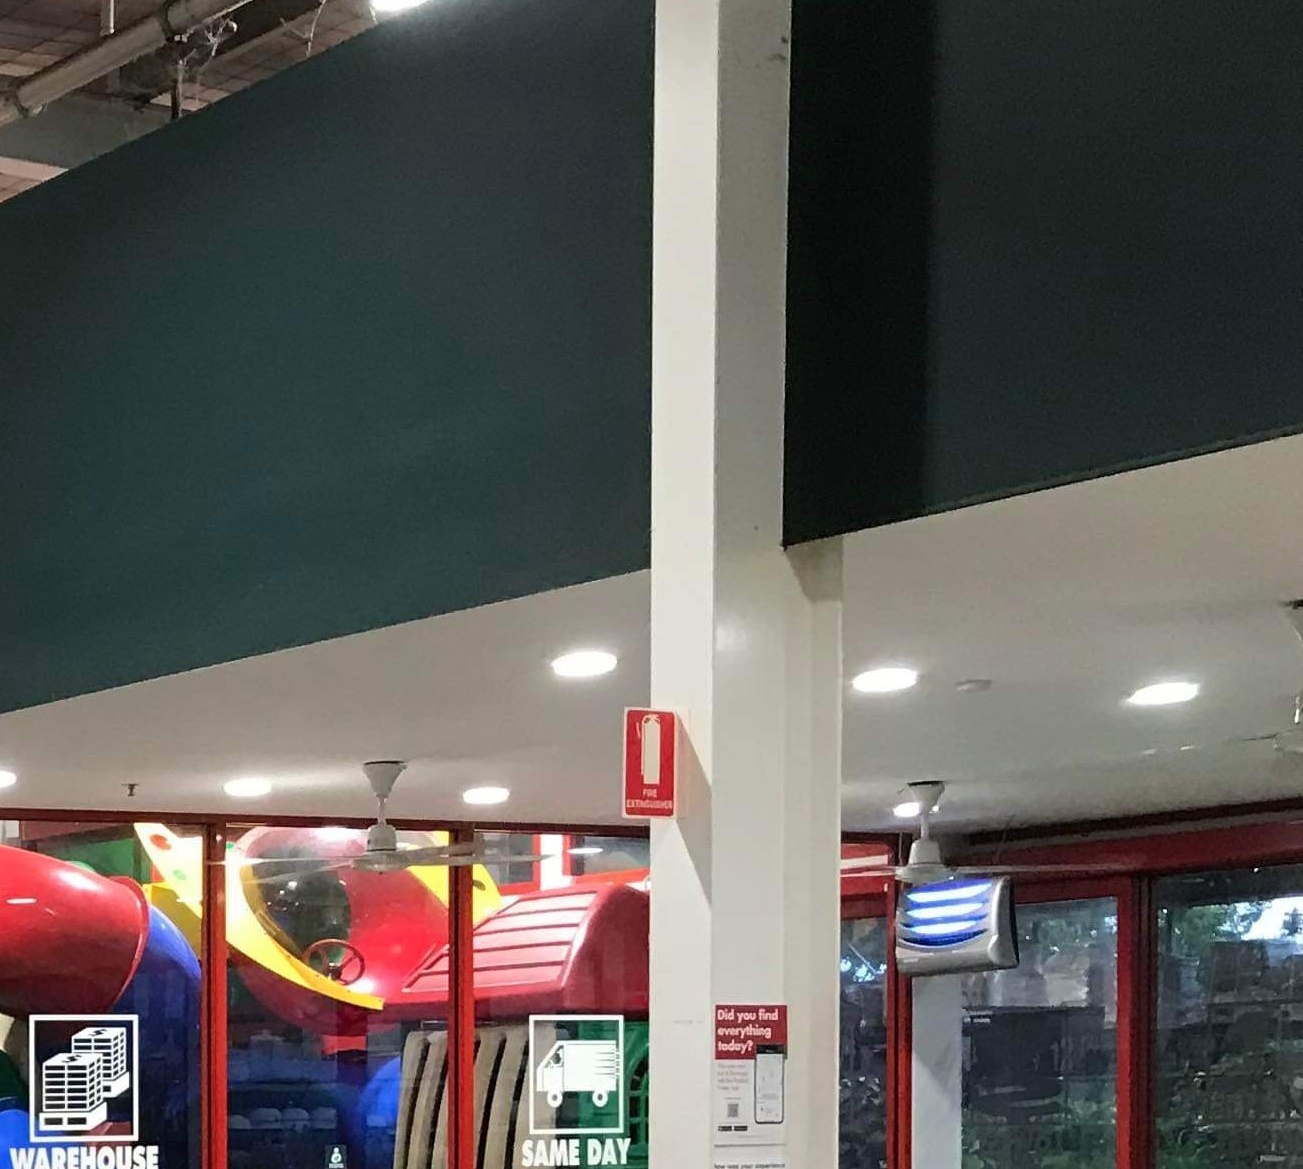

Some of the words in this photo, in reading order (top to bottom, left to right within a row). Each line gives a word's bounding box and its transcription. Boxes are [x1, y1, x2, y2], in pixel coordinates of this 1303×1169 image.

[717, 1009, 735, 1020] Did
[737, 1012, 757, 1023] you
[758, 1008, 779, 1020] find
[717, 1024, 772, 1039] everything
[717, 1039, 754, 1054] today?
[521, 1138, 580, 1167] SAME
[587, 1137, 631, 1165] DAY
